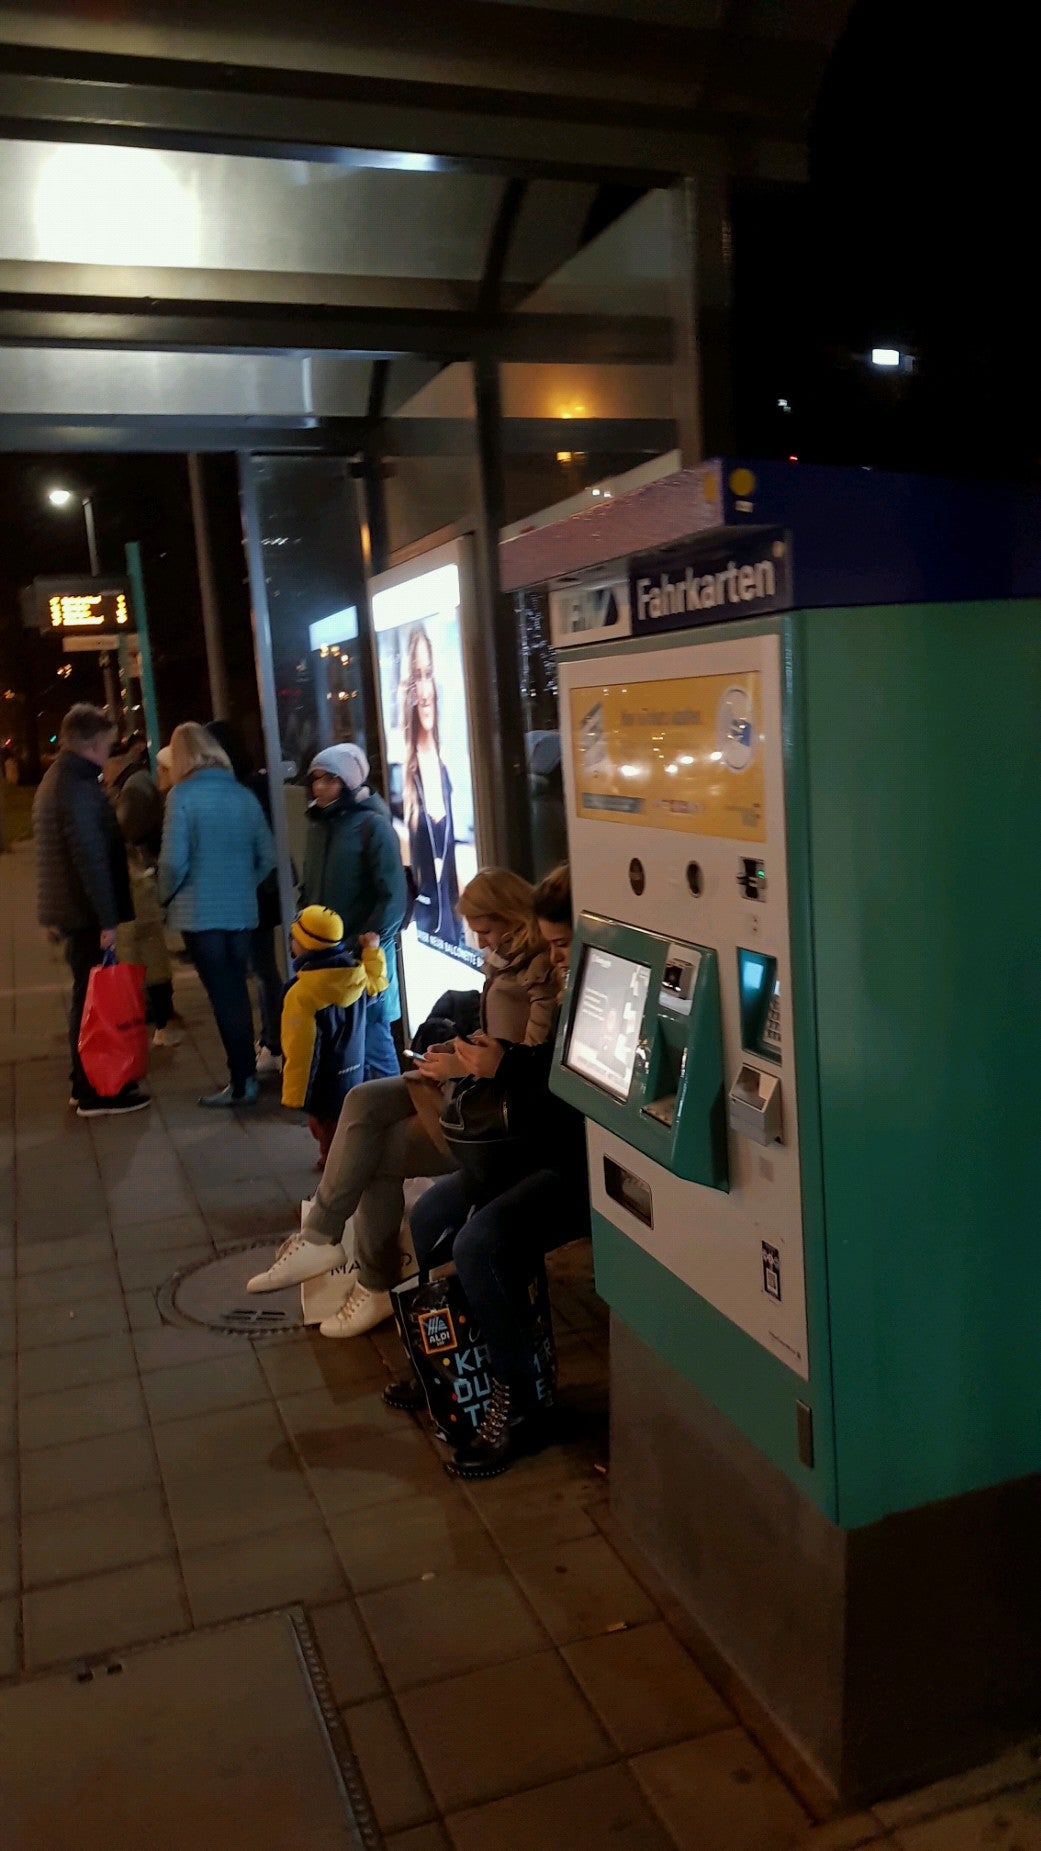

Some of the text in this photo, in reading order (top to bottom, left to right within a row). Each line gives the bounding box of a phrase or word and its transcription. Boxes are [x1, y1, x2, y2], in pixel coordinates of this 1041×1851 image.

[635, 560, 776, 621] Fahrkarten
[330, 1252, 413, 1276] MAO
[430, 1330, 451, 1344] ALDI
